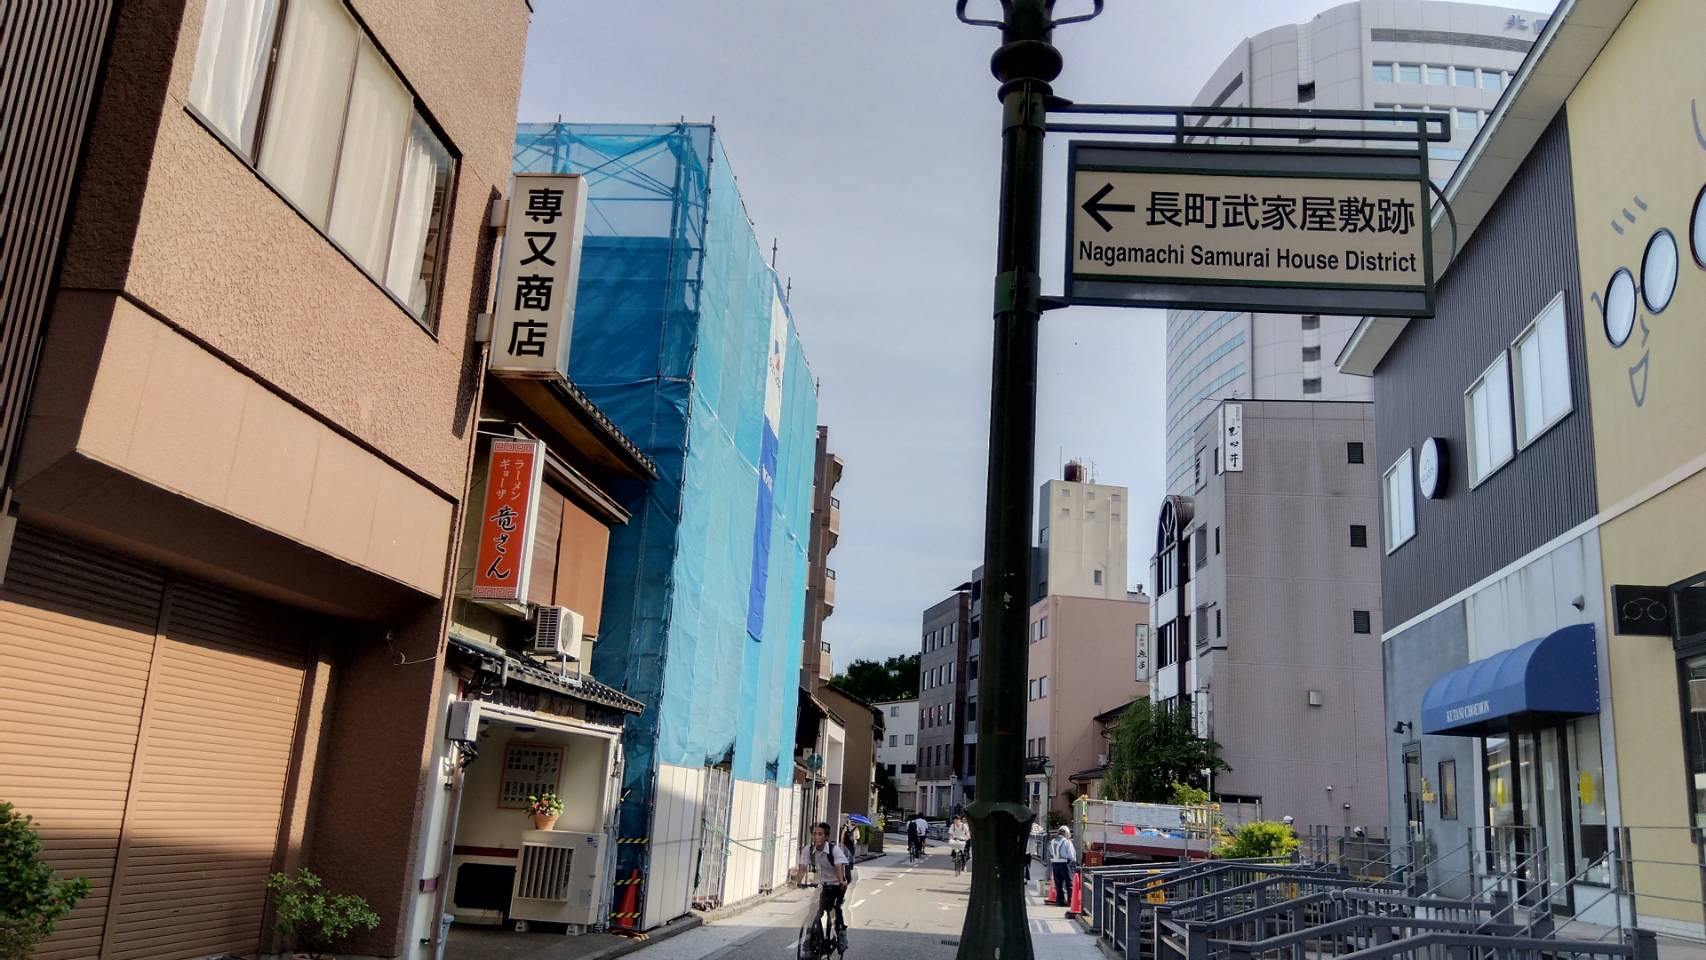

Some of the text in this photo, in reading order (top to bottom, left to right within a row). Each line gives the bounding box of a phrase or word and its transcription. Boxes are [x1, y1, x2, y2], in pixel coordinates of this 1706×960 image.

[1145, 191, 1415, 236] 長町武家屋敷跡
[507, 188, 563, 357] 専又商店
[1079, 240, 1417, 272] Nagamachi Samurai House District
[496, 459, 511, 500] ギョーザ
[511, 459, 525, 501] ラーメン
[486, 505, 518, 580] 竜さん
